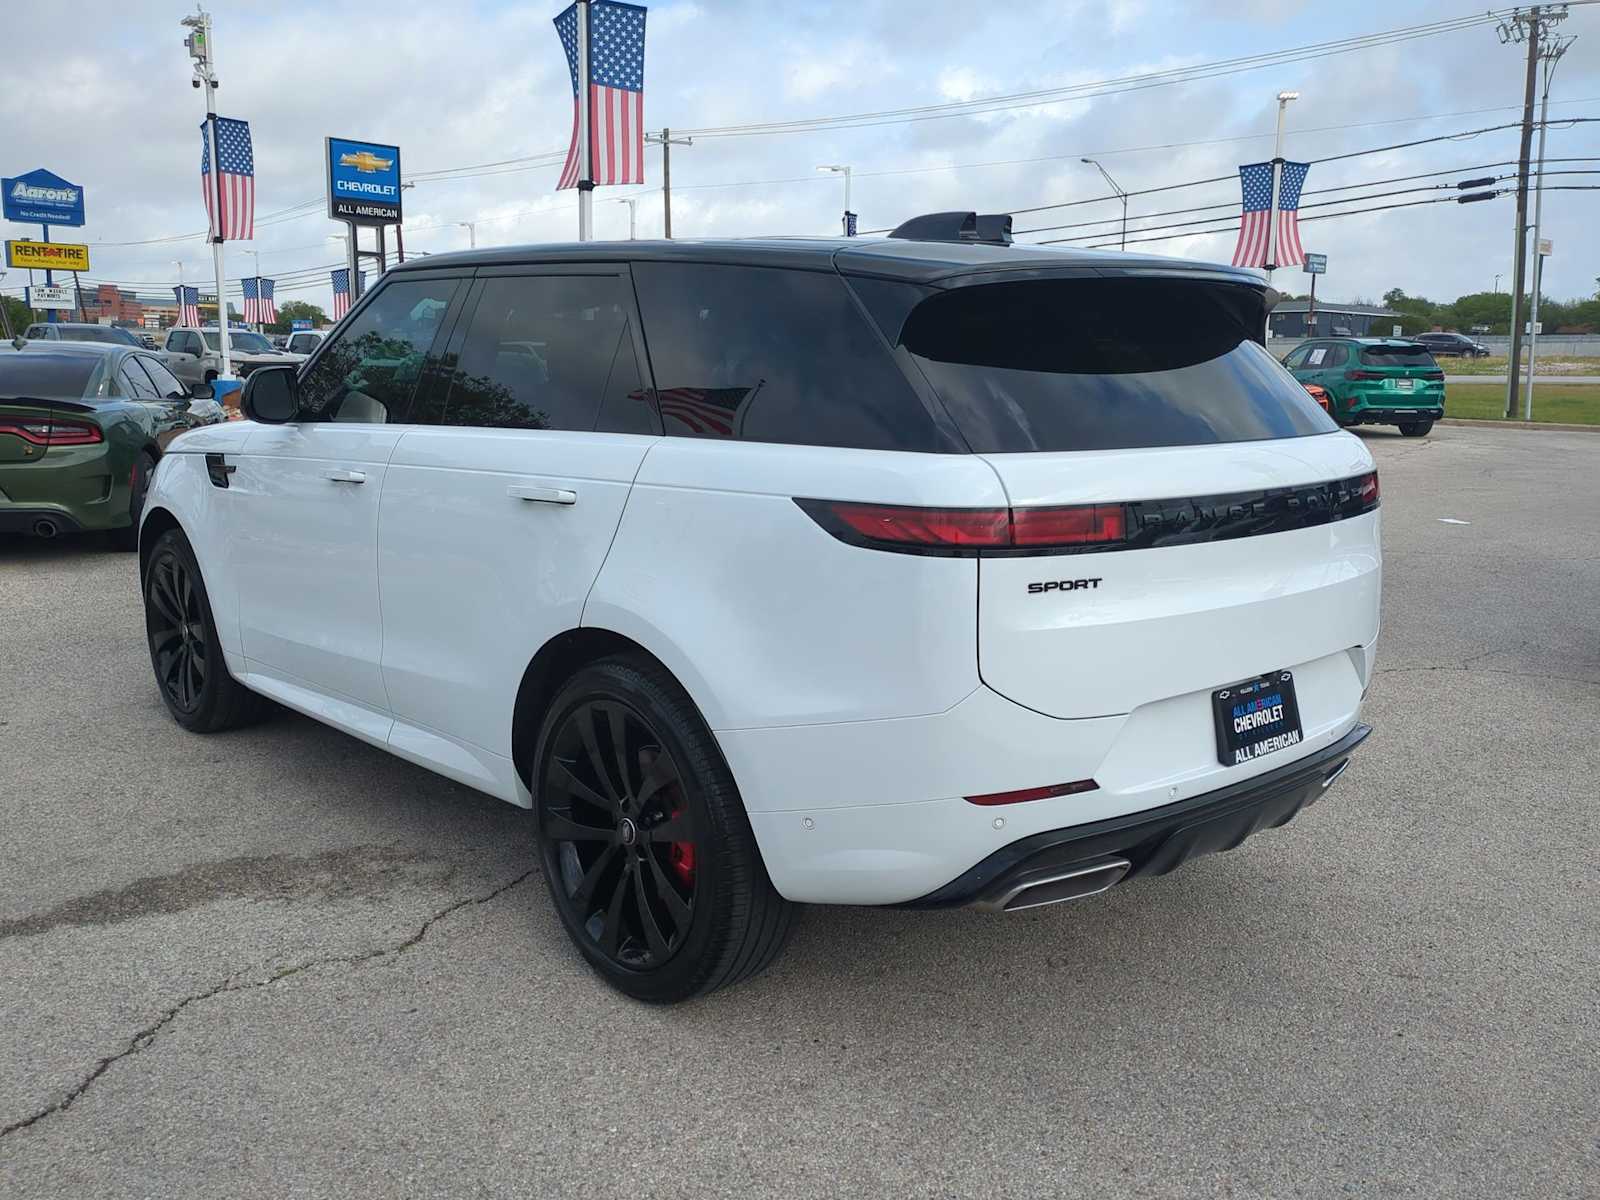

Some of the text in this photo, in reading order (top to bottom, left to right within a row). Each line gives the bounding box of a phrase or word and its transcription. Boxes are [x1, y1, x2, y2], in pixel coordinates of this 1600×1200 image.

[12, 182, 78, 202] Aaron's
[337, 180, 396, 195] CHEVROLET
[338, 204, 398, 218] ALL AMERICAN
[1028, 577, 1103, 594] SPORT
[1233, 704, 1284, 733] CHEVROLET
[1235, 747, 1253, 763] ALL
[1254, 730, 1300, 757] AMERICAN
